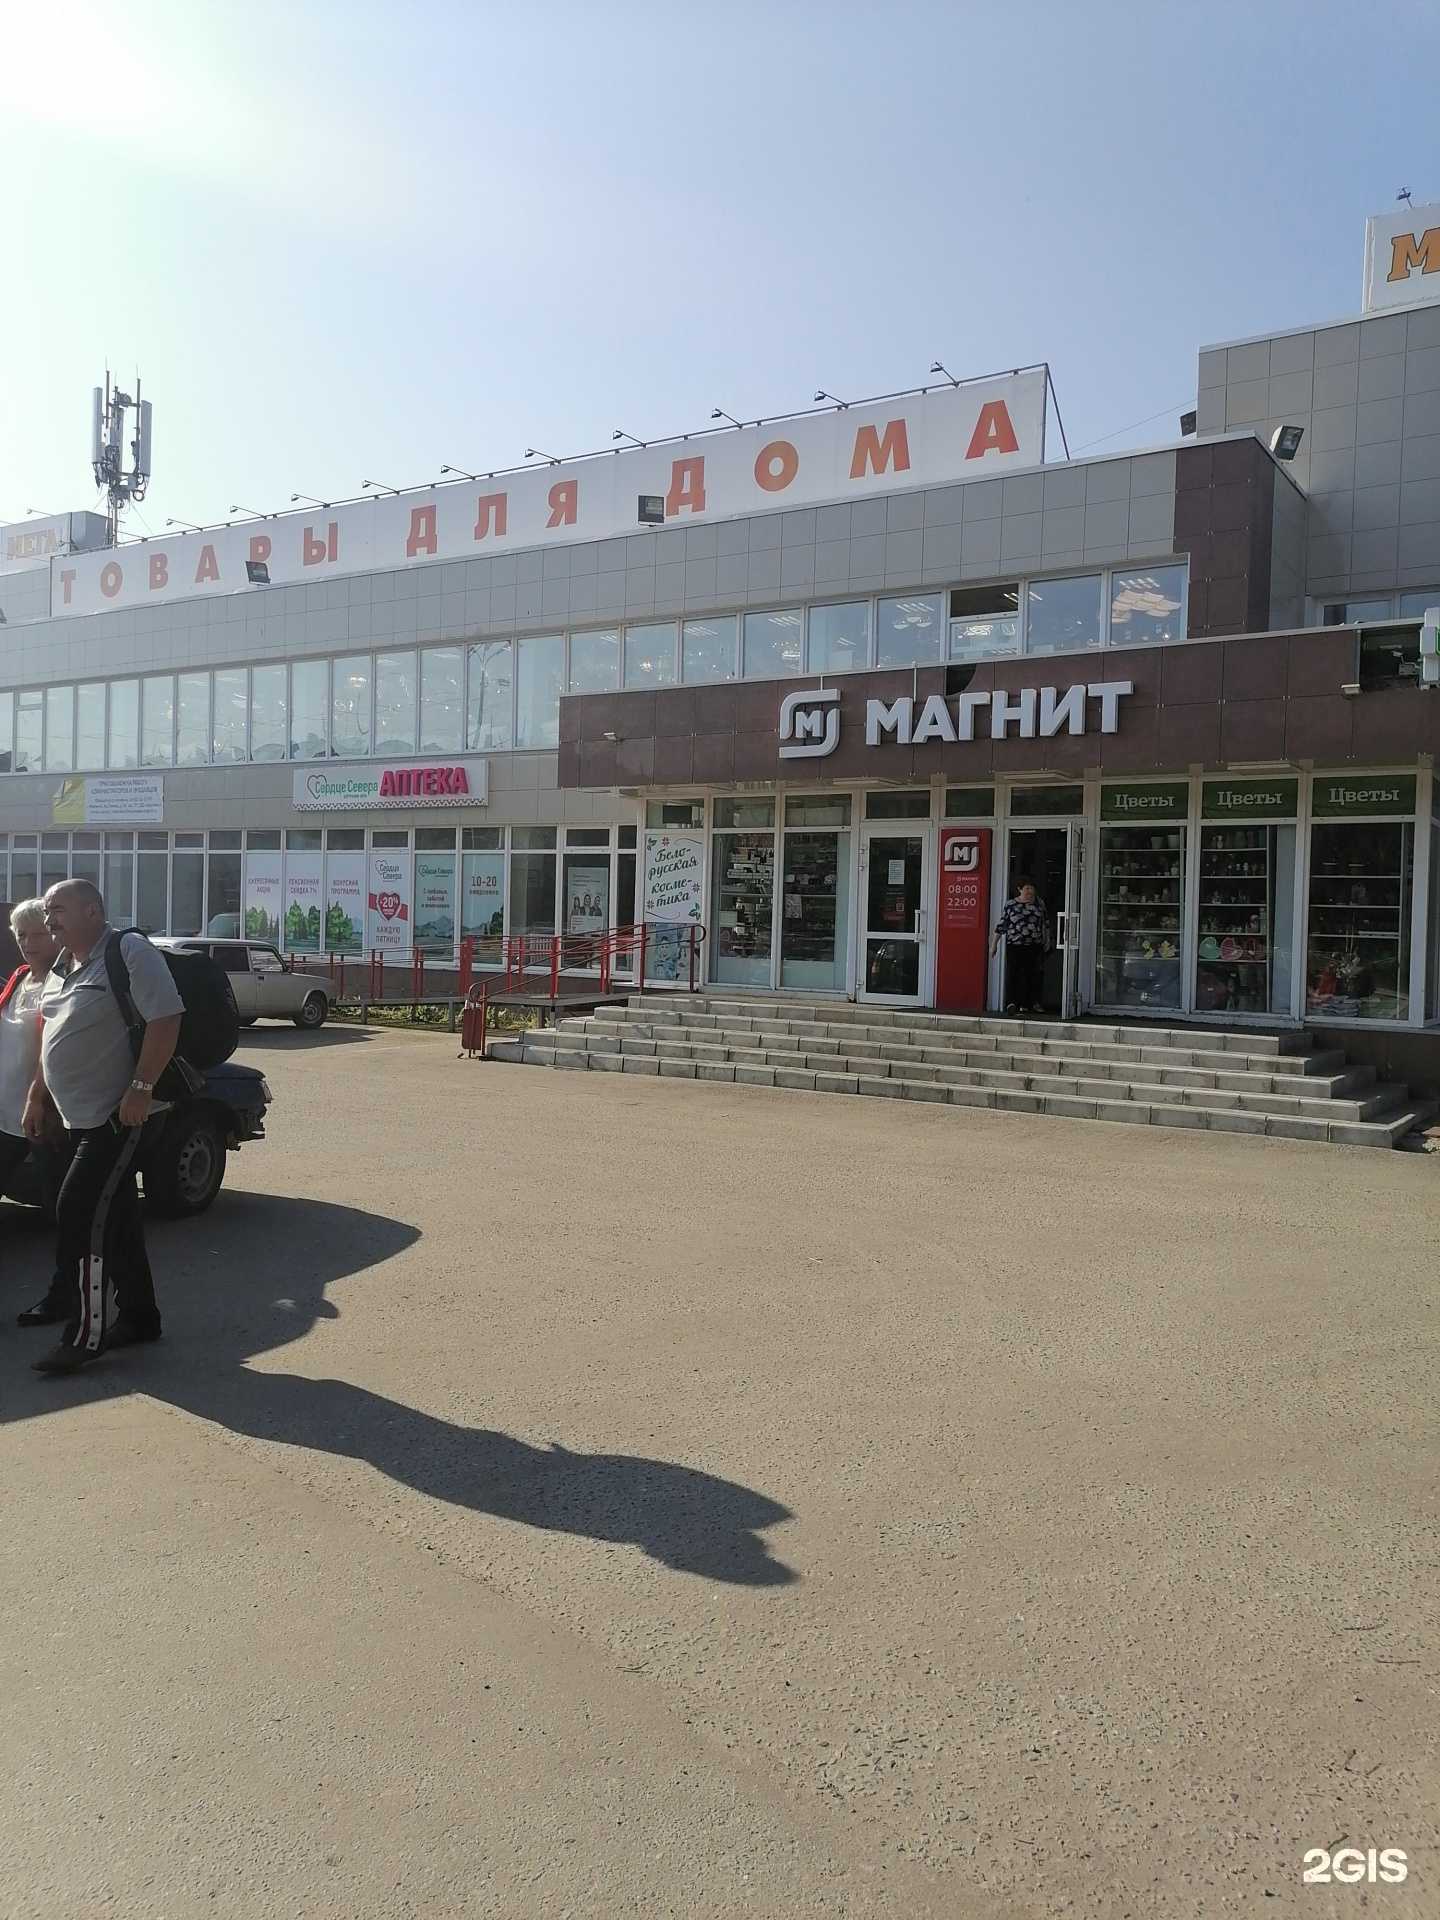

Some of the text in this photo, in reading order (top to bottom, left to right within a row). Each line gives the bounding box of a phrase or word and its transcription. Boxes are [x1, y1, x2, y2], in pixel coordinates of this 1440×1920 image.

[61, 399, 1020, 604] ТОВАРЫ ДЛЯ ДОМА
[866, 681, 1134, 745] МАГНИТ
[347, 780, 378, 795] Севера
[380, 767, 469, 796] АПТЕКА
[1113, 794, 1175, 809] Цветы
[1217, 791, 1283, 808] Цветы
[1328, 788, 1400, 805] Цветы
[648, 856, 697, 880] русская
[472, 876, 497, 887] 10-20
[948, 885, 977, 894] 08:00
[656, 892, 689, 907] тика
[947, 898, 976, 907] 22:00
